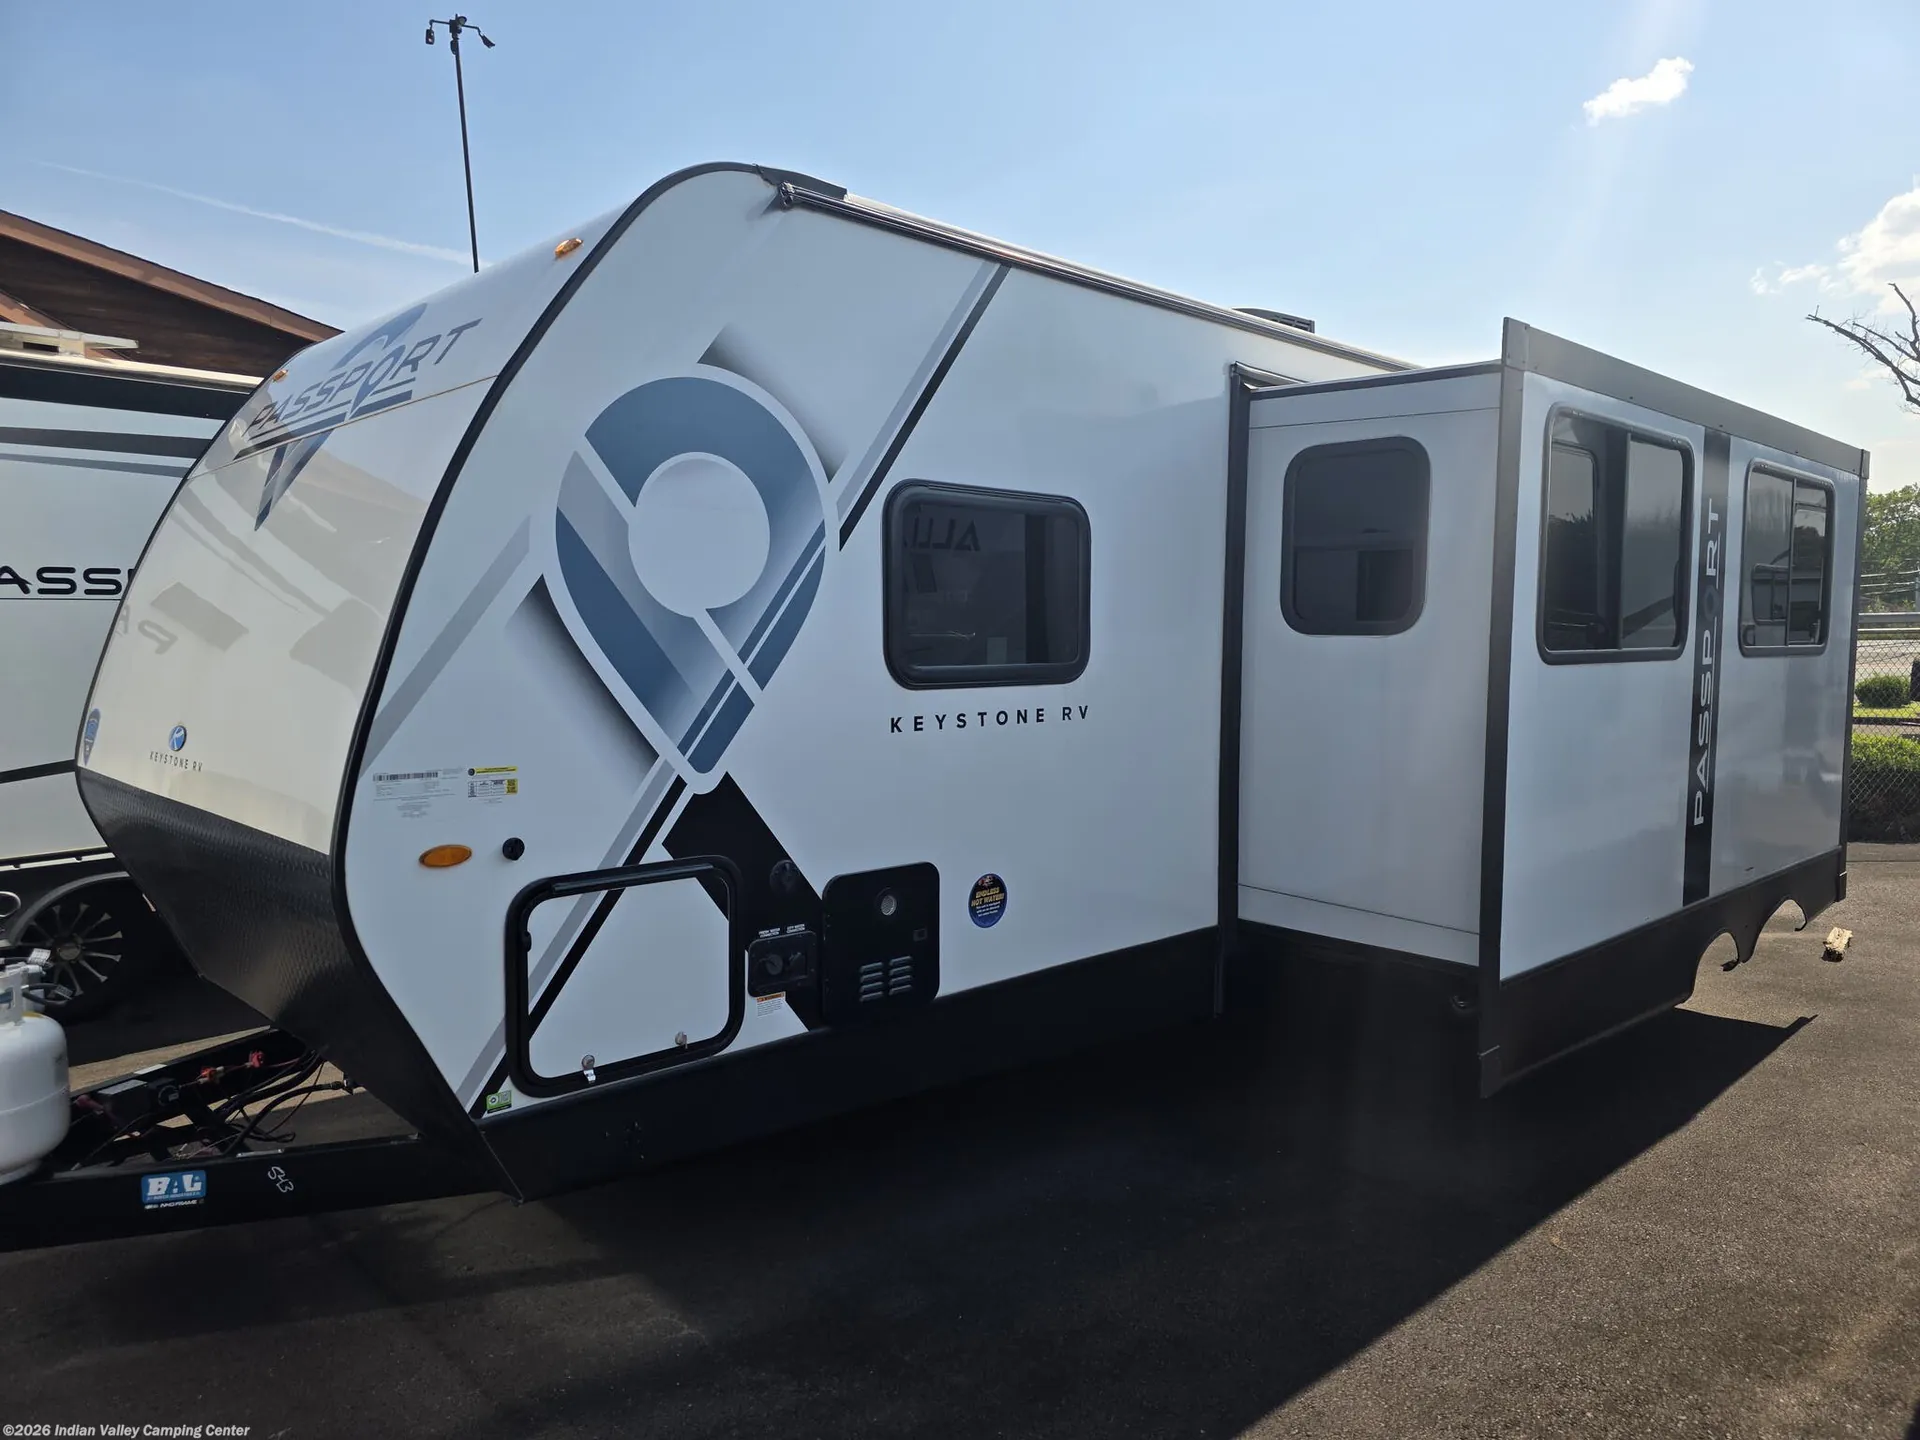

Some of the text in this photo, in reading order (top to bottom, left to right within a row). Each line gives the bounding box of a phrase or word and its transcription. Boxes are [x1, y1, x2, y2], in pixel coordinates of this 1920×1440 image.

[241, 317, 483, 437] PASSPORT
[1693, 498, 1719, 825] PASSPORT
[890, 705, 1088, 733] KEYSTONE RV
[149, 751, 203, 772] KEYSTONE RV
